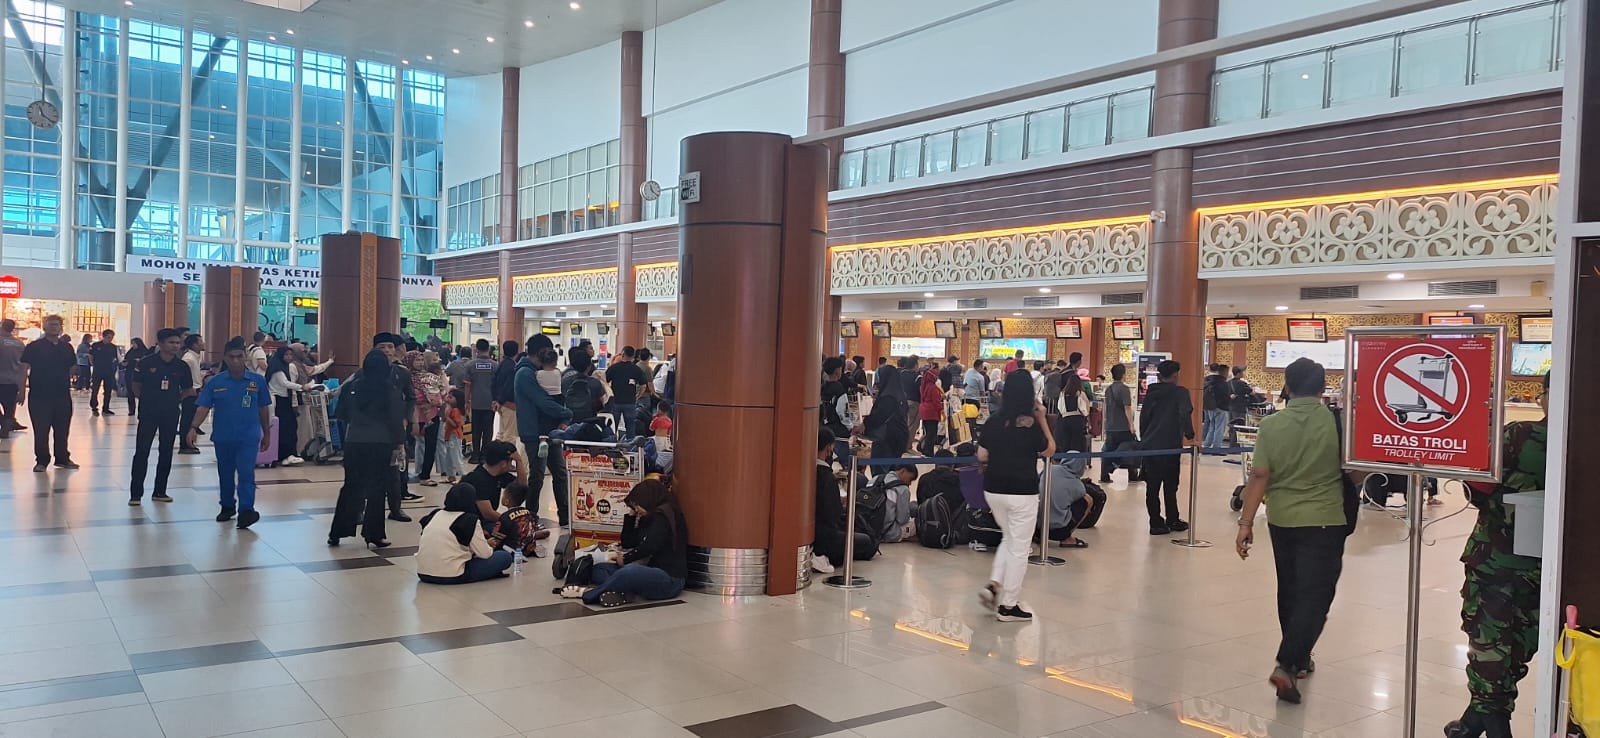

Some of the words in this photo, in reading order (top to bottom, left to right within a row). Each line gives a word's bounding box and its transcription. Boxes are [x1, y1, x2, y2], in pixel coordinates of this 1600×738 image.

[681, 178, 697, 188] FREE
[141, 259, 196, 270] MOHON
[402, 277, 433, 287] NNYA
[183, 272, 201, 282] SE
[278, 279, 317, 288] AKTIV
[1373, 434, 1419, 447] BATAS
[1423, 437, 1467, 450] TROLI
[1384, 448, 1427, 459] TROLLEY
[1429, 452, 1455, 461] LIMIT
